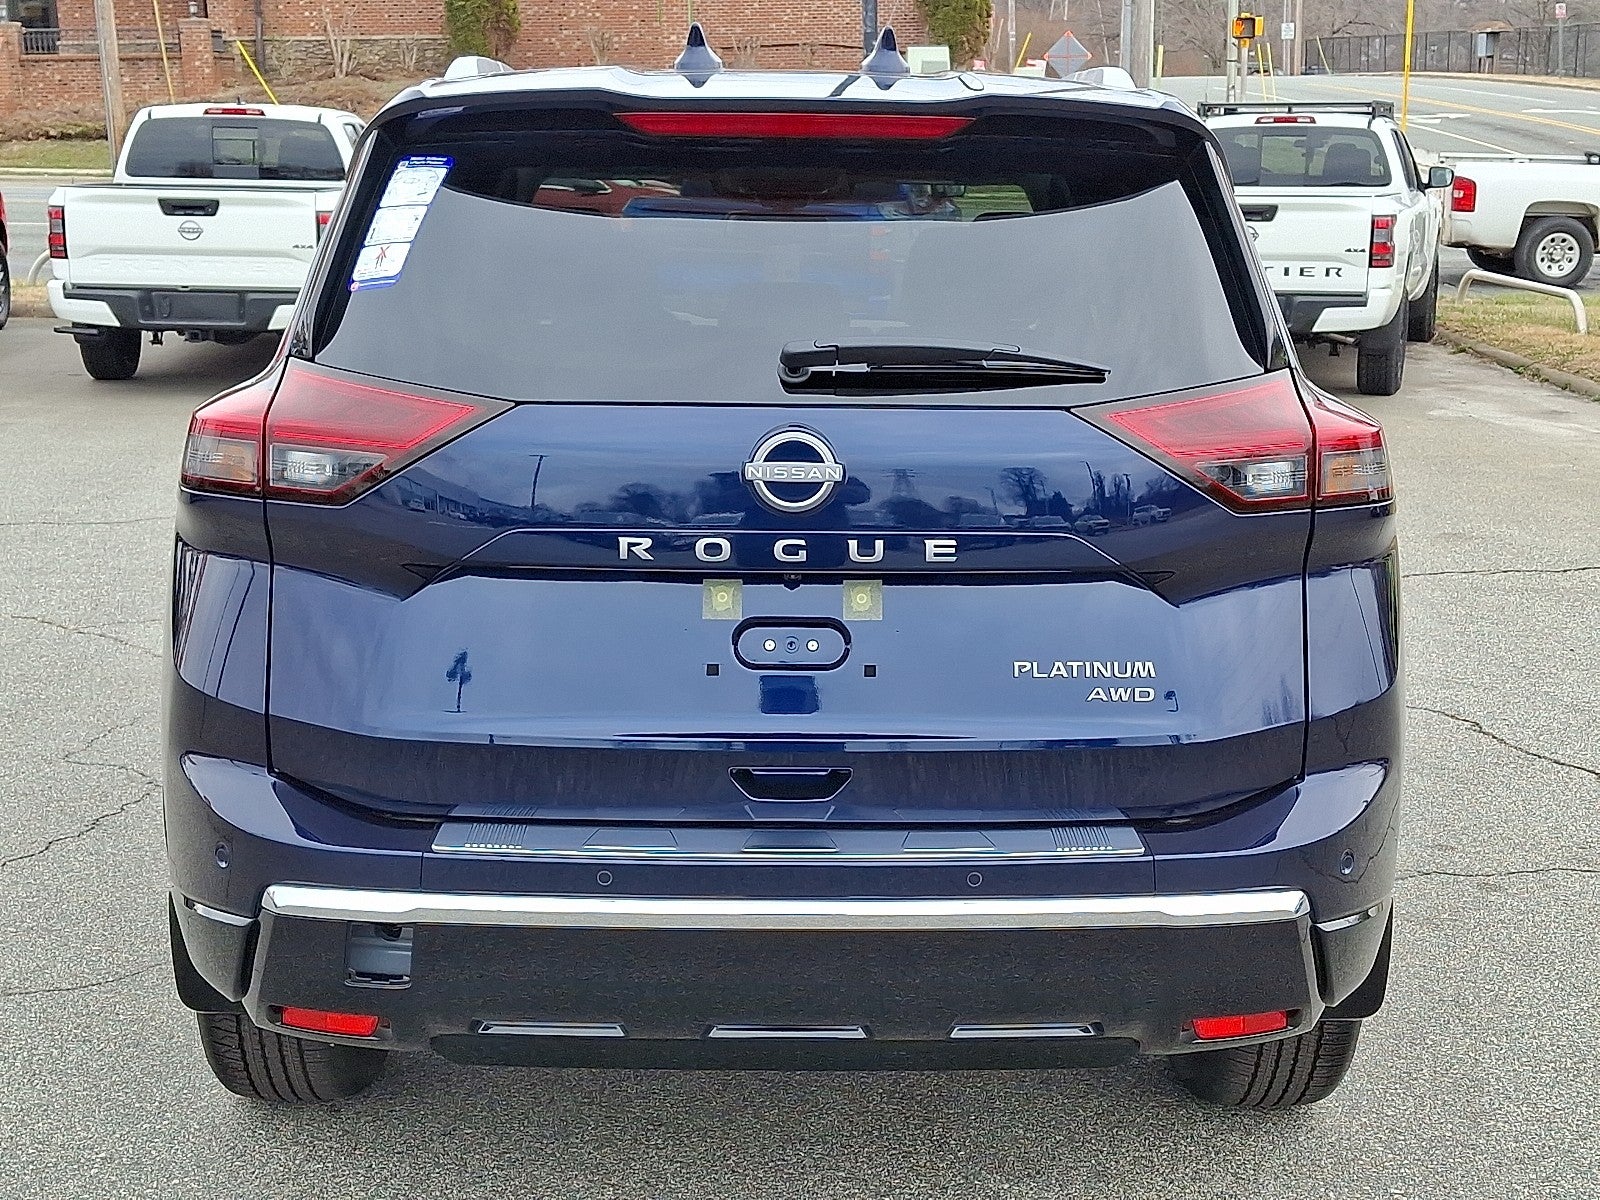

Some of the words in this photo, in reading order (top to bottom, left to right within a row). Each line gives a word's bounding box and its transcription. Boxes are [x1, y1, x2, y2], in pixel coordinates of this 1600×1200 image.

[748, 465, 840, 480] NISSAN
[618, 536, 958, 563] ROGUE
[1012, 660, 1157, 679] PLATINUM
[1085, 686, 1156, 703] AWD
